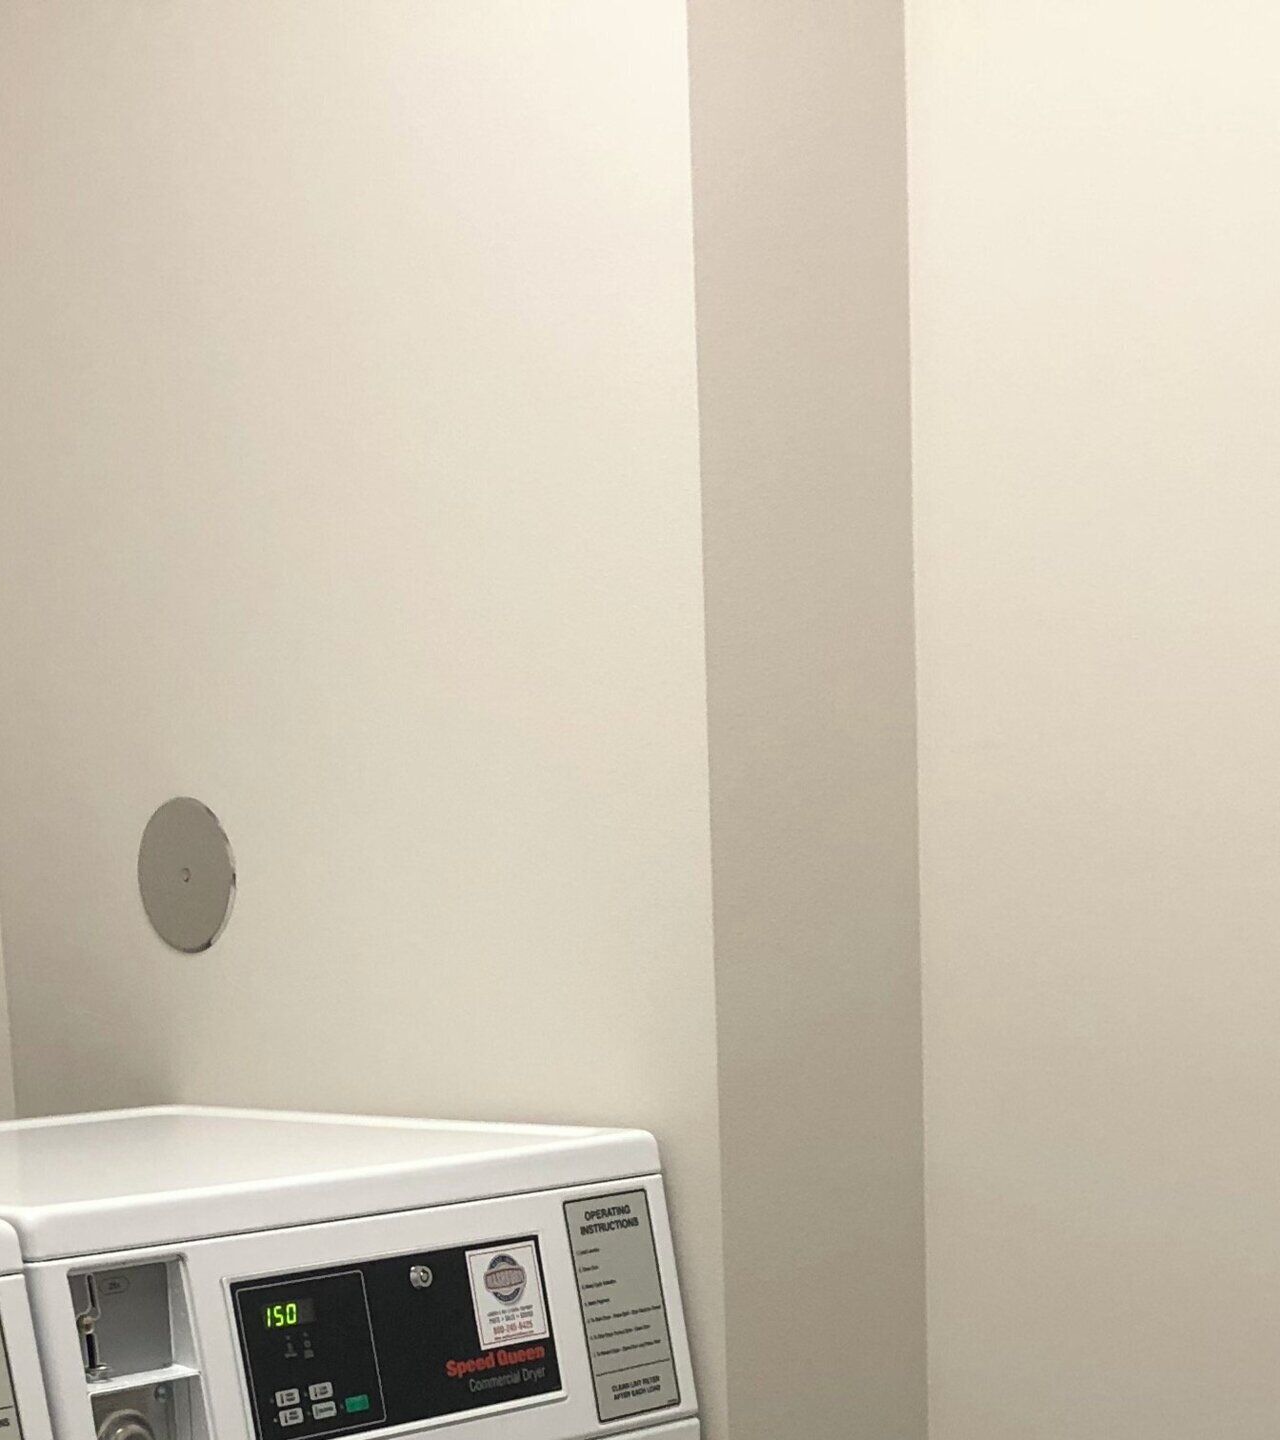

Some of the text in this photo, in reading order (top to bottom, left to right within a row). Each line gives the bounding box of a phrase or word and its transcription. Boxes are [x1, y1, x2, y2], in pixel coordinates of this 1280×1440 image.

[584, 1205, 631, 1221] OPERATING
[580, 1217, 639, 1235] INSTRUCTIONS
[267, 1303, 297, 1327] 150
[445, 1346, 545, 1378] Speed Queen
[469, 1367, 545, 1392] Commercial Dryer
